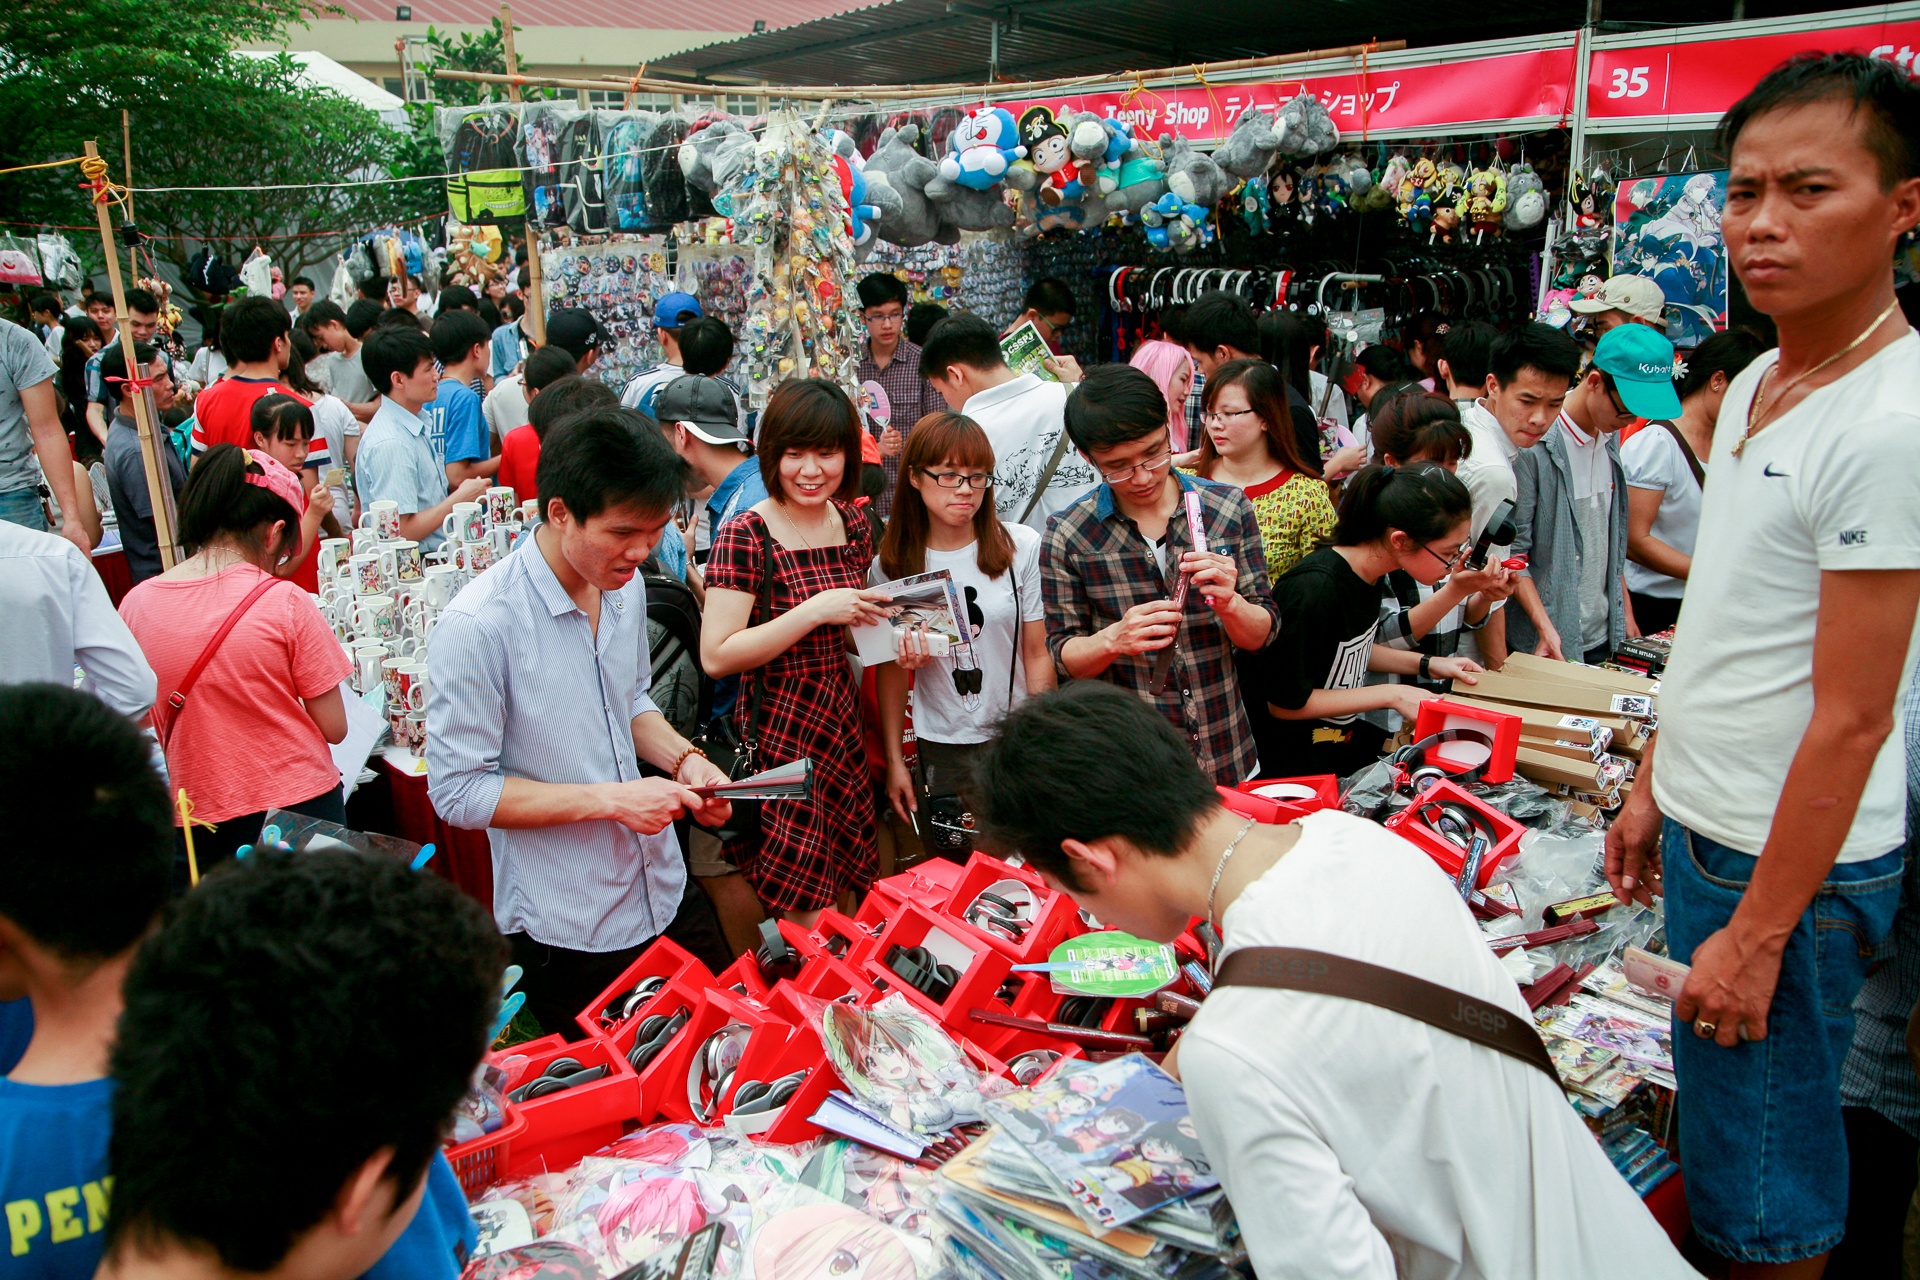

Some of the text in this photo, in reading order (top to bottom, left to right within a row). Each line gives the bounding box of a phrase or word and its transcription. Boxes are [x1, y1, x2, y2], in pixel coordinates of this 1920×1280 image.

[1607, 66, 1650, 99] 35
[1105, 101, 1210, 131] Teeny Shop
[1007, 331, 1035, 354] CSSPJ
[1839, 530, 1868, 546] NIKE
[1250, 955, 1329, 980] Jeep
[1451, 1000, 1508, 1035] Jeep
